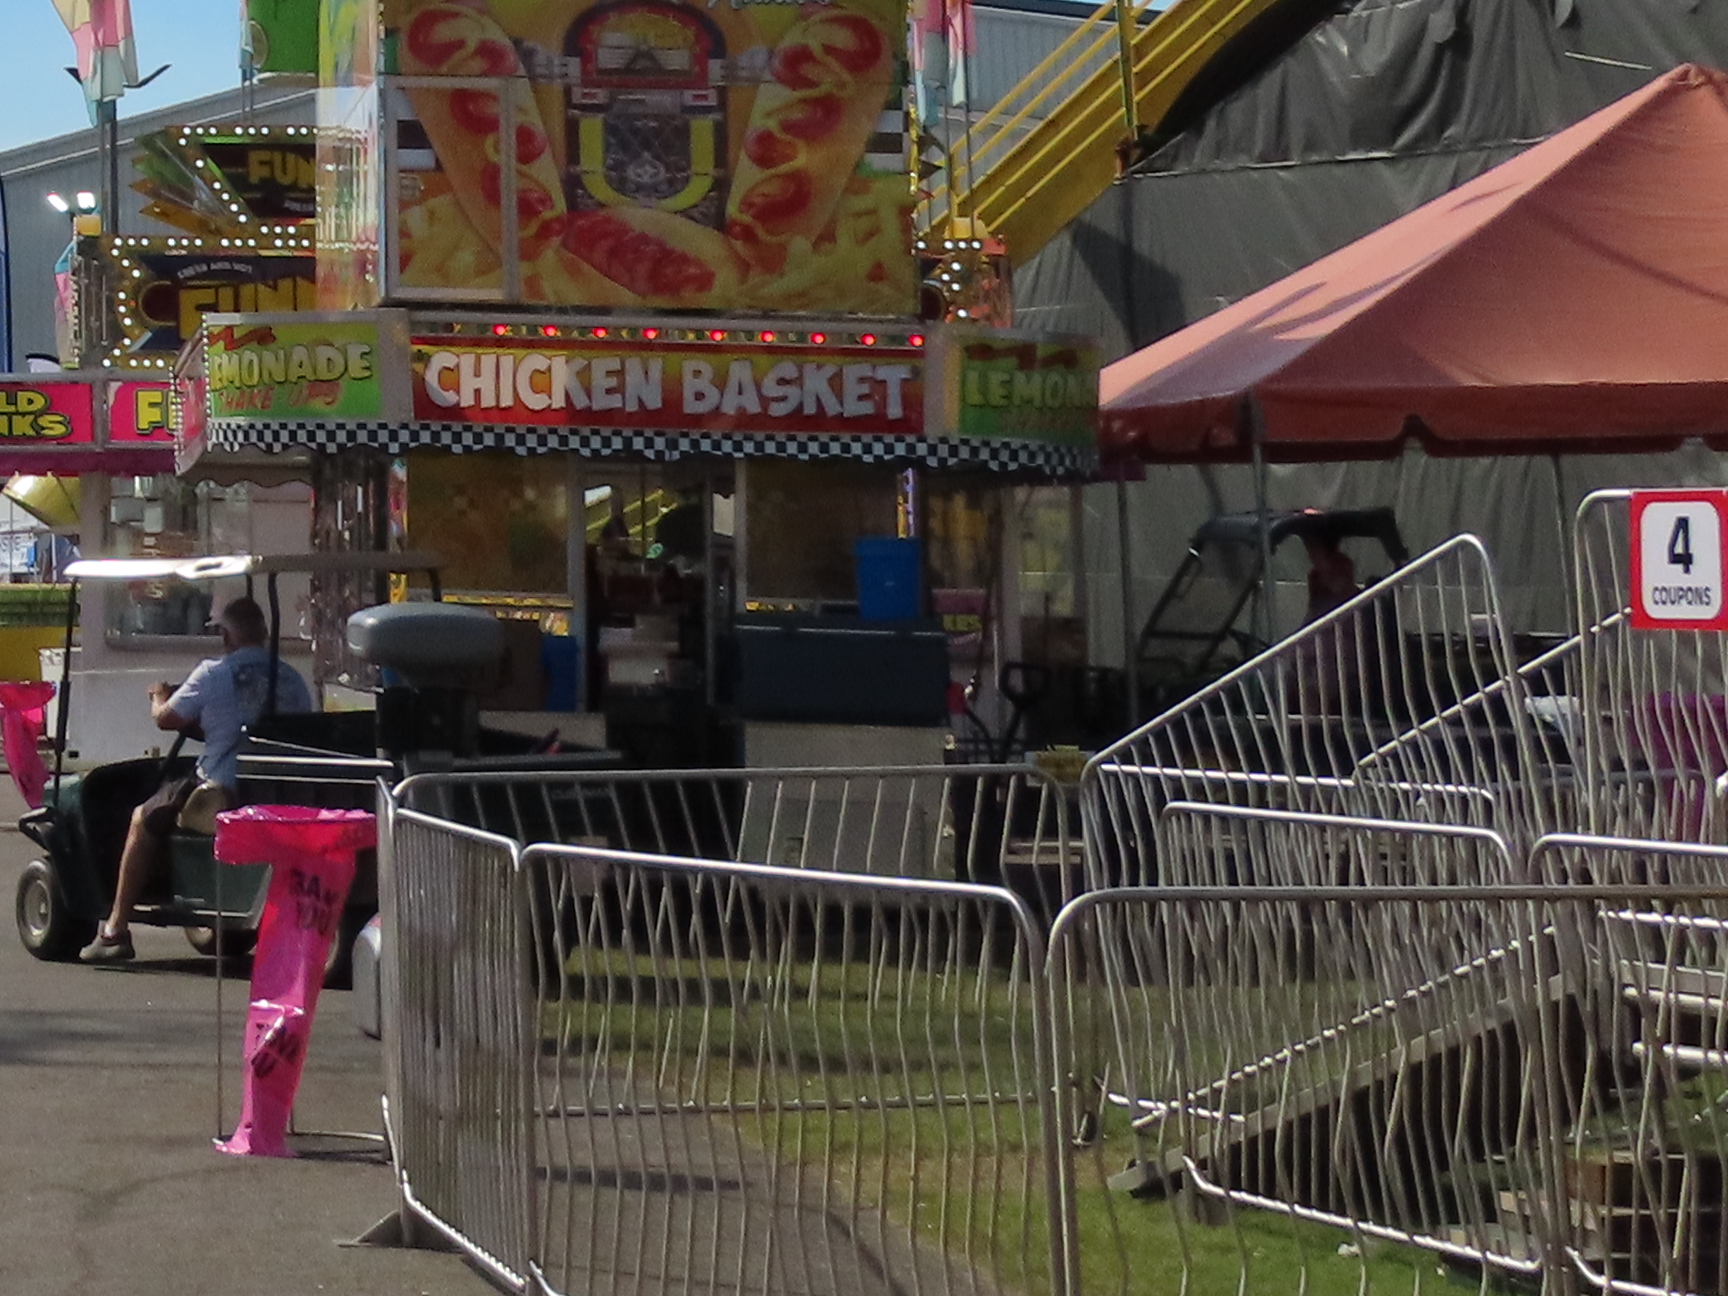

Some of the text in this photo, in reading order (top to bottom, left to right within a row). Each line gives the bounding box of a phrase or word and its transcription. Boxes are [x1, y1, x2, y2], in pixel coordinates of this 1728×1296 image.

[423, 350, 914, 421] CHICKEN BASKET
[1668, 515, 1694, 575] 4
[1651, 585, 1712, 607] COUPONS
